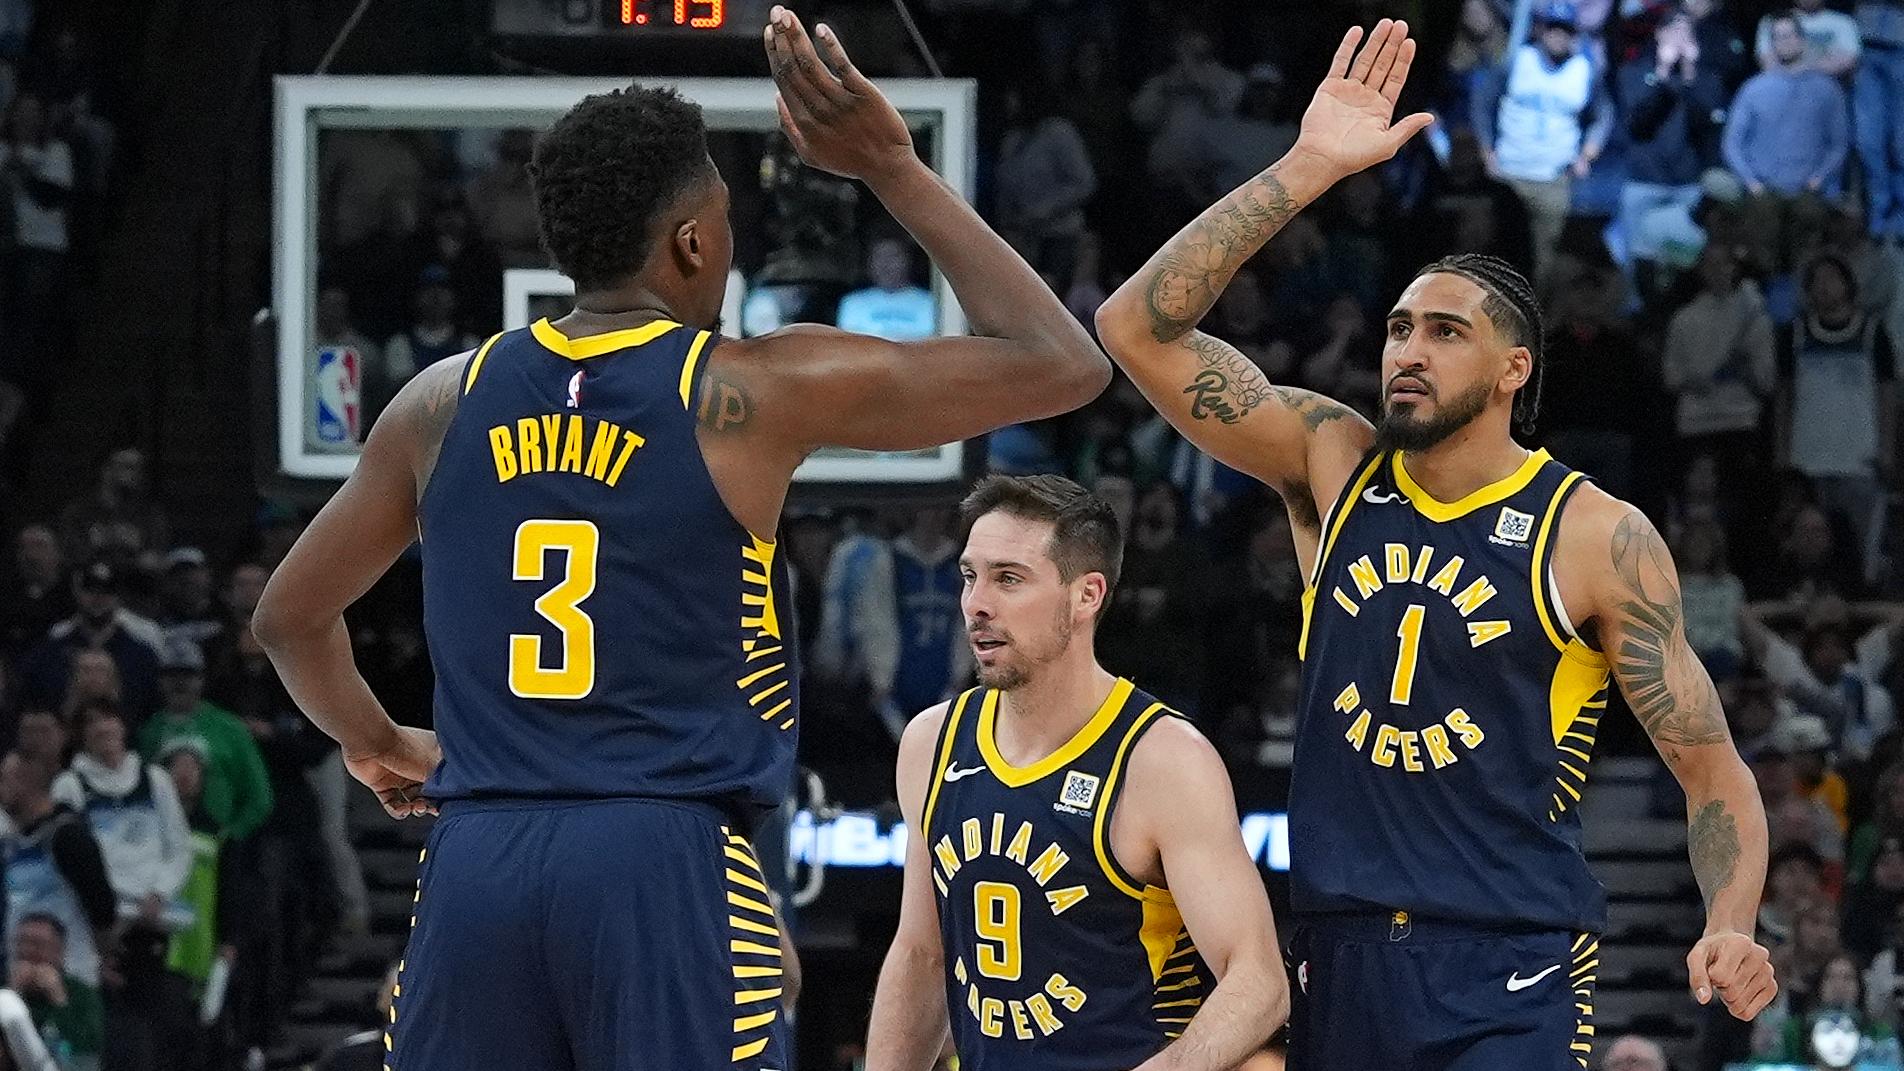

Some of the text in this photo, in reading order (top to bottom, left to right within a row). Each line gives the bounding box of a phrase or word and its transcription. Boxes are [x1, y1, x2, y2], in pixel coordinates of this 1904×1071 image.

[489, 413, 646, 488] BRYANT
[508, 519, 599, 699] 3
[1333, 543, 1512, 648] INDIANA
[1389, 604, 1426, 706] 1
[1333, 682, 1485, 772] PACERS
[933, 812, 1089, 916] INDIANA
[974, 881, 1022, 981] 9
